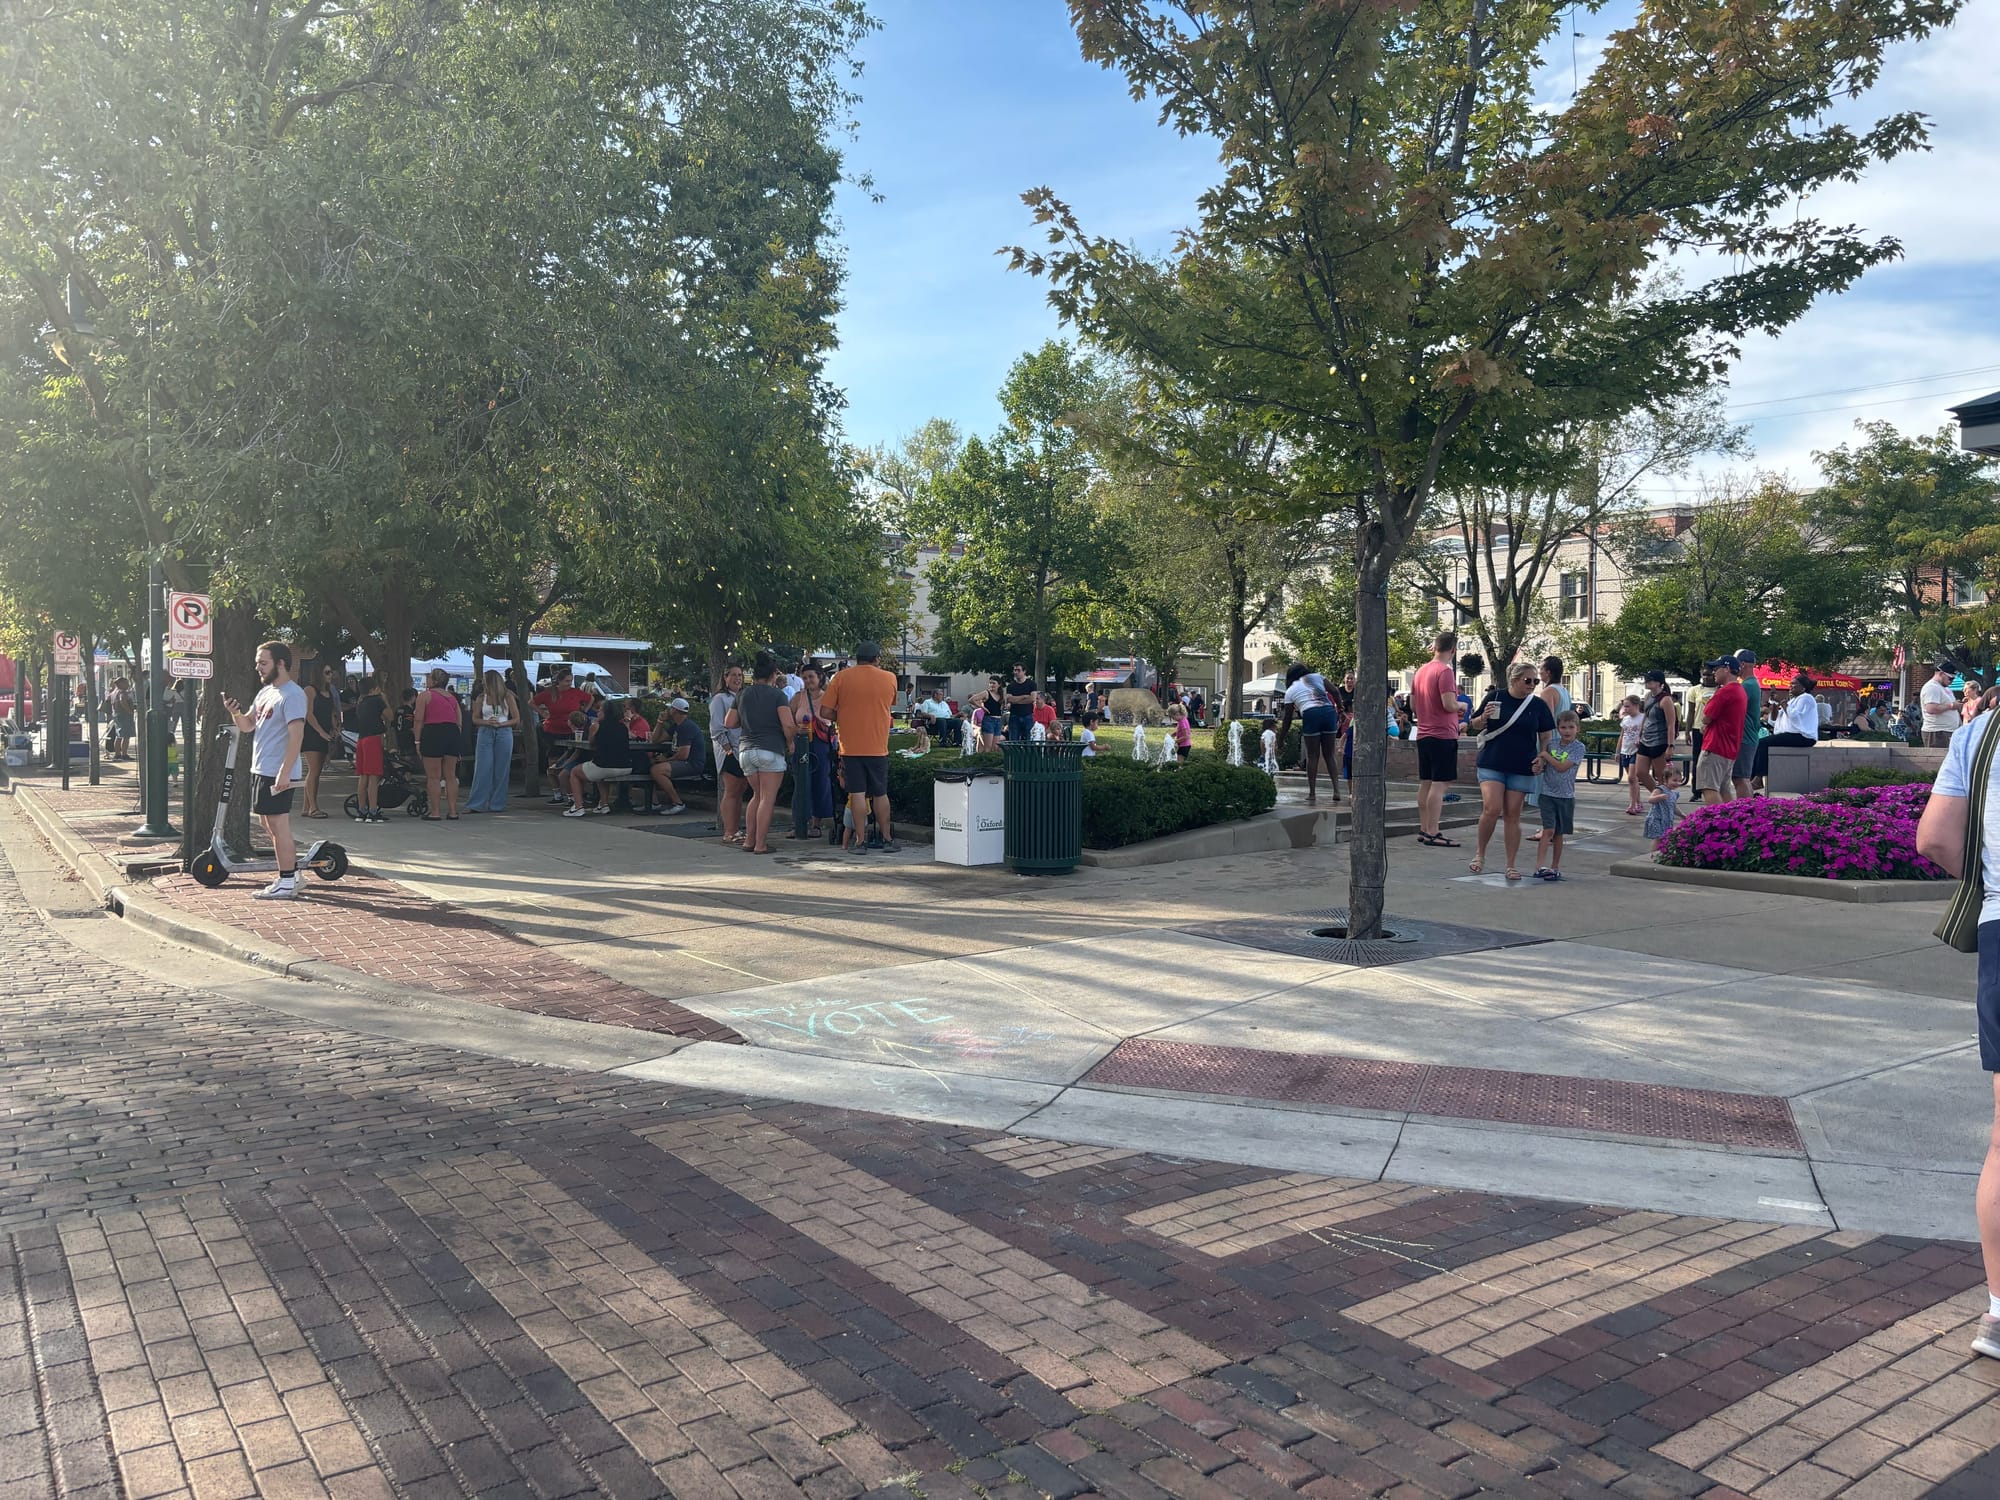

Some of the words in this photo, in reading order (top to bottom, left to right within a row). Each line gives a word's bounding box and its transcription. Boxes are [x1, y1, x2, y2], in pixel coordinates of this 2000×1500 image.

[177, 640, 188, 648] 30
[190, 640, 205, 649] MIN
[222, 774, 233, 797] BIRD
[980, 819, 1003, 828] Oxford
[761, 997, 954, 1039] VOTE
